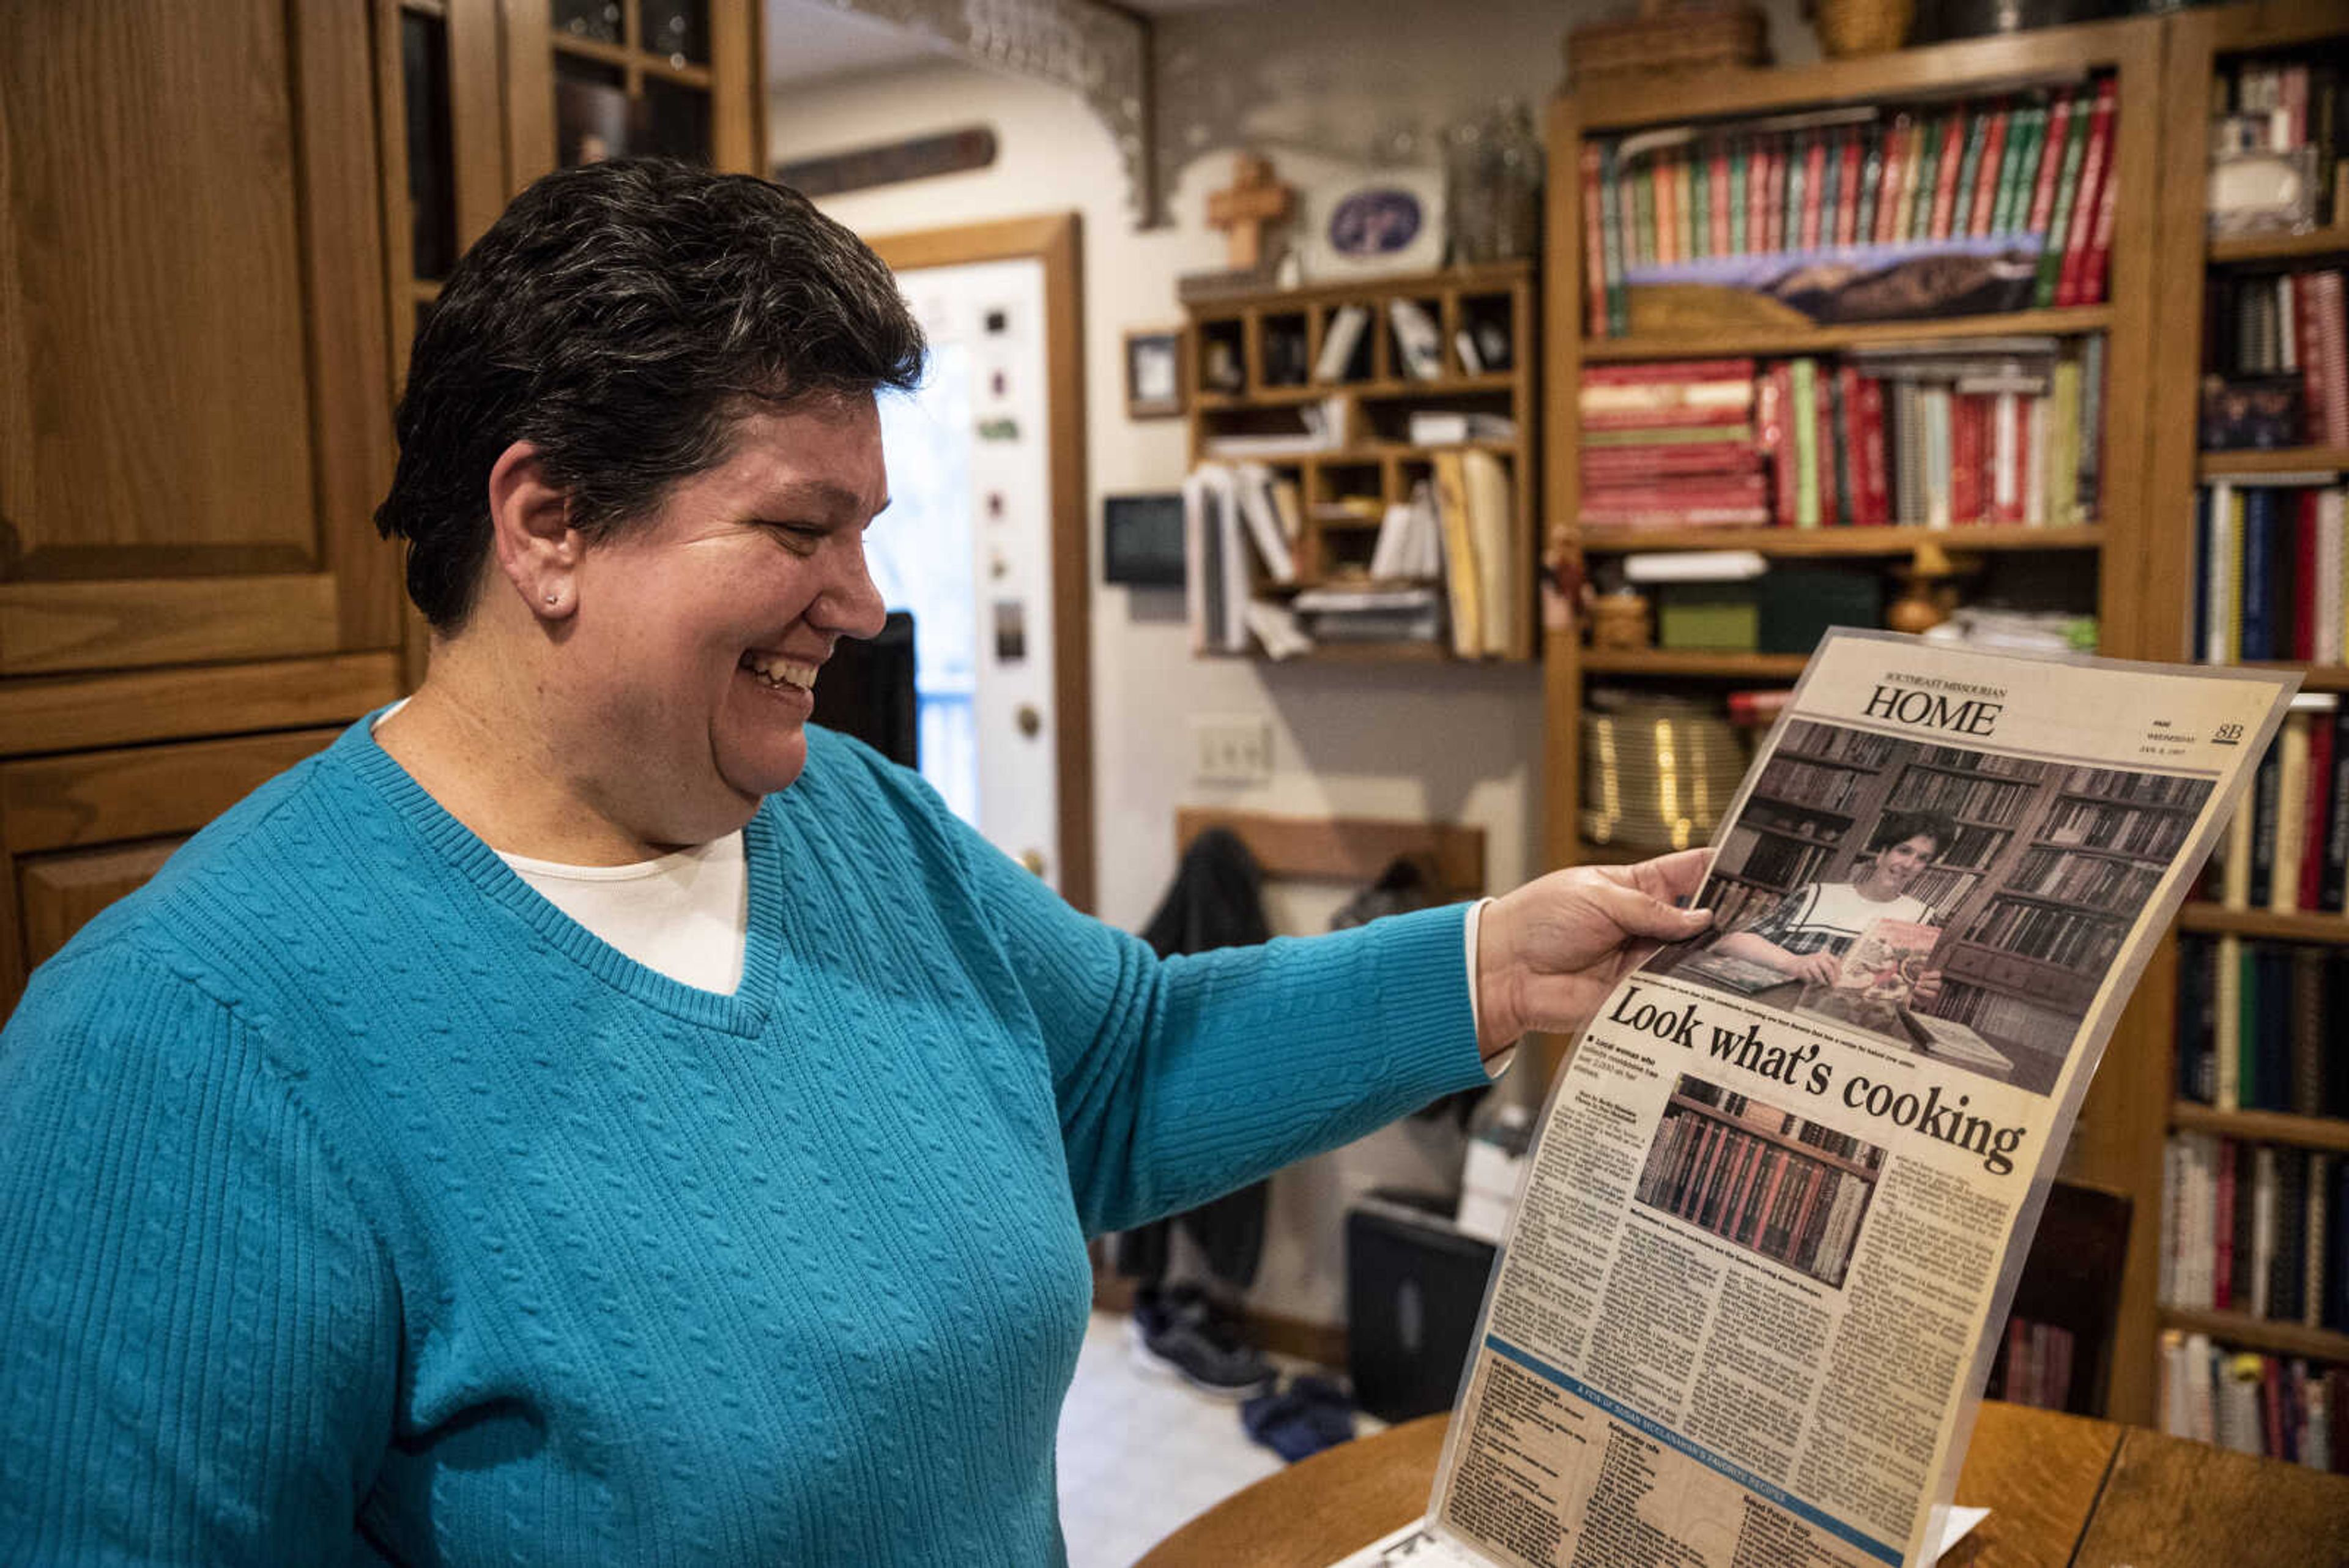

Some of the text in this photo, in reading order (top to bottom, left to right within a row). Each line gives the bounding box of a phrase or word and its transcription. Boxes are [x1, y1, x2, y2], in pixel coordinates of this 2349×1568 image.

[1862, 685, 2003, 736] HOME
[2215, 723, 2244, 740] 8B
[1608, 986, 2027, 1175] Look what's cooking
